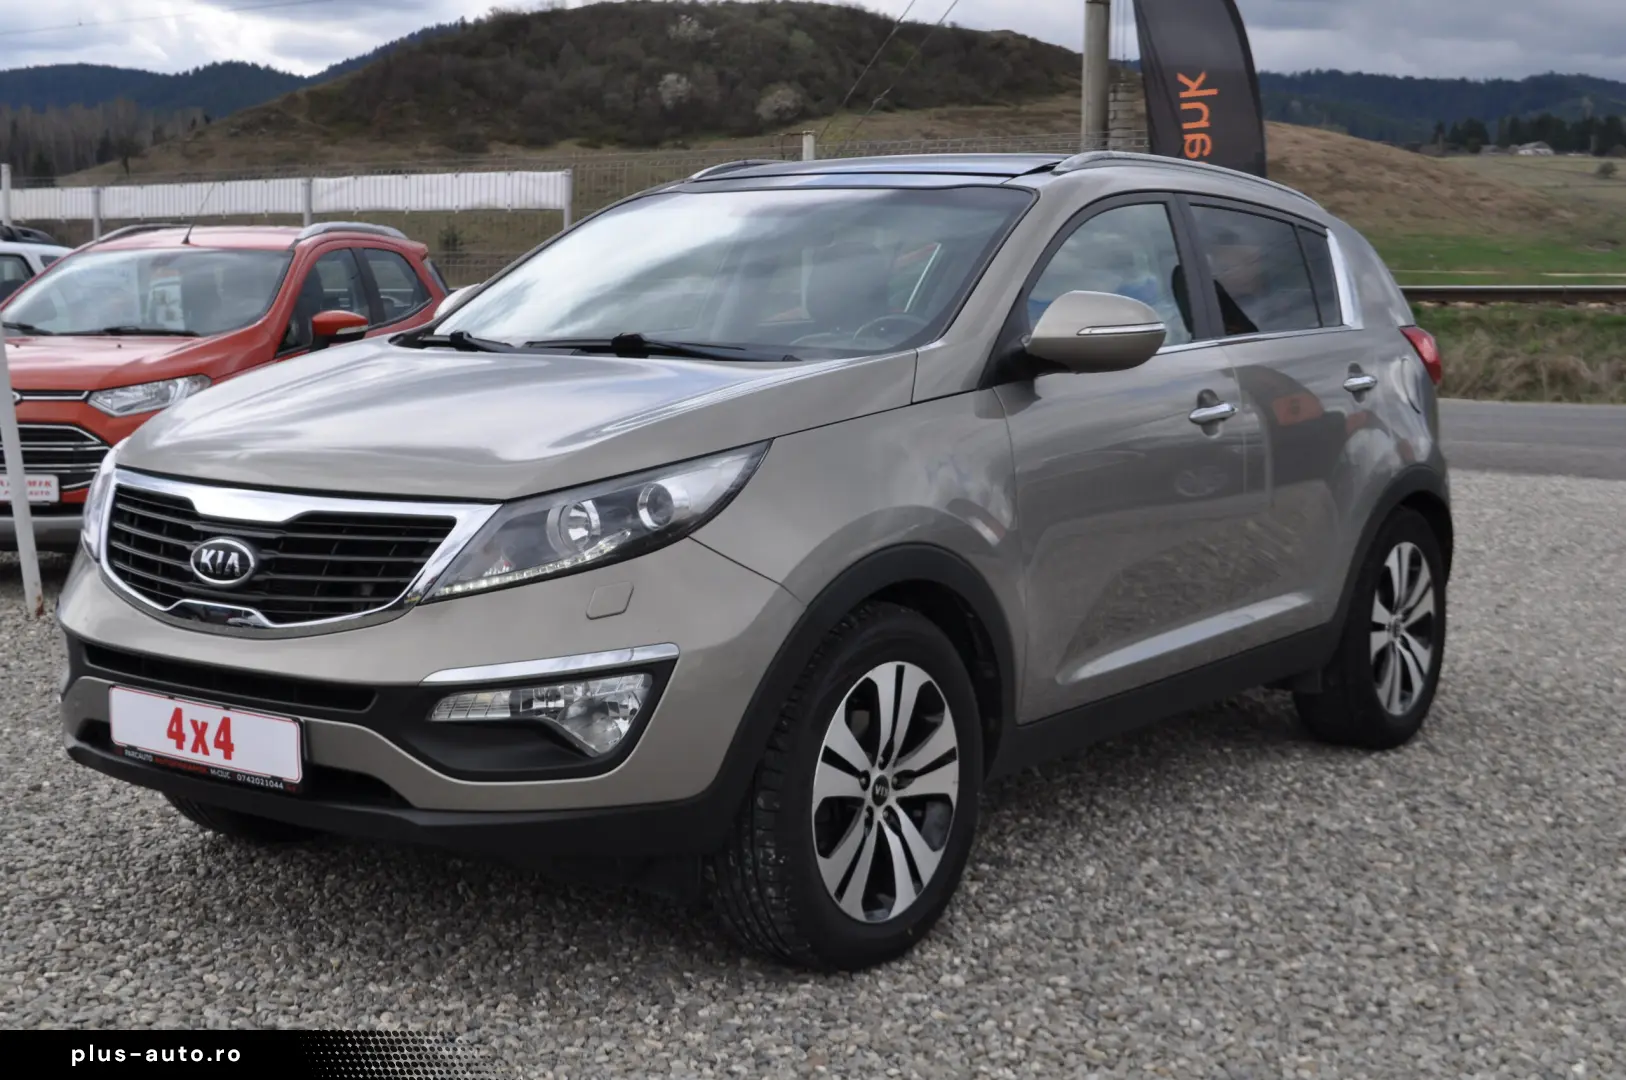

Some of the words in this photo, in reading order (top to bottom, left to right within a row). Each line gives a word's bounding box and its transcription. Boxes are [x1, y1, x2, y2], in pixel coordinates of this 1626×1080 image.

[201, 548, 240, 577] KIA
[167, 707, 235, 761] 4x4
[236, 773, 284, 789] 0742021044
